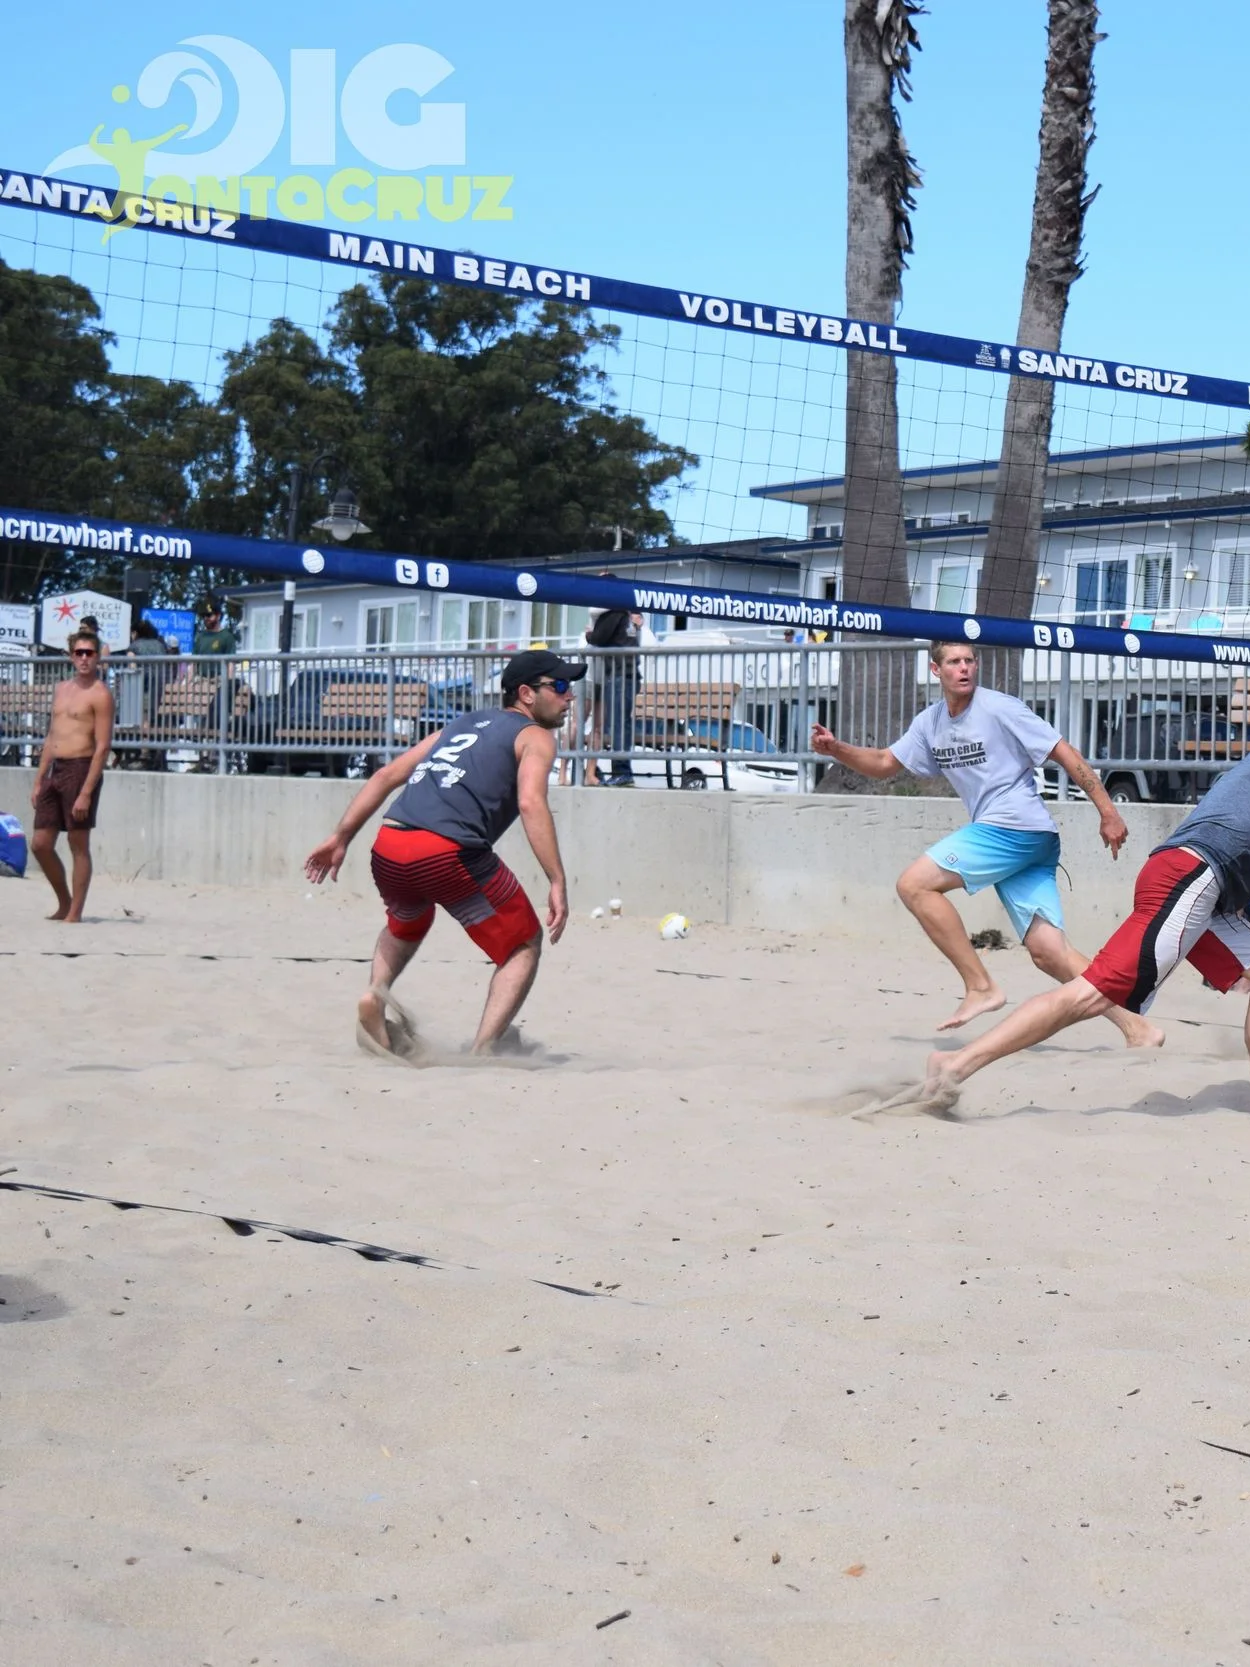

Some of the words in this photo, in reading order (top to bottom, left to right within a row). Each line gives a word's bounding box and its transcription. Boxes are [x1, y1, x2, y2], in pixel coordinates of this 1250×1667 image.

[0, 173, 114, 218] ANTA
[125, 197, 236, 240] CRUZ
[329, 233, 435, 275] MAIN
[454, 255, 591, 301] BEACH
[679, 293, 907, 353] VOLLEYBALL
[1018, 349, 1109, 384] SANTA
[1115, 365, 1189, 396] CRUZ
[0, 516, 191, 559] cruzwharf.com
[634, 589, 882, 630] www.santacruzwharf.com
[432, 733, 478, 762] 2
[932, 747, 957, 758] SANTA
[957, 741, 985, 756] CRUZ
